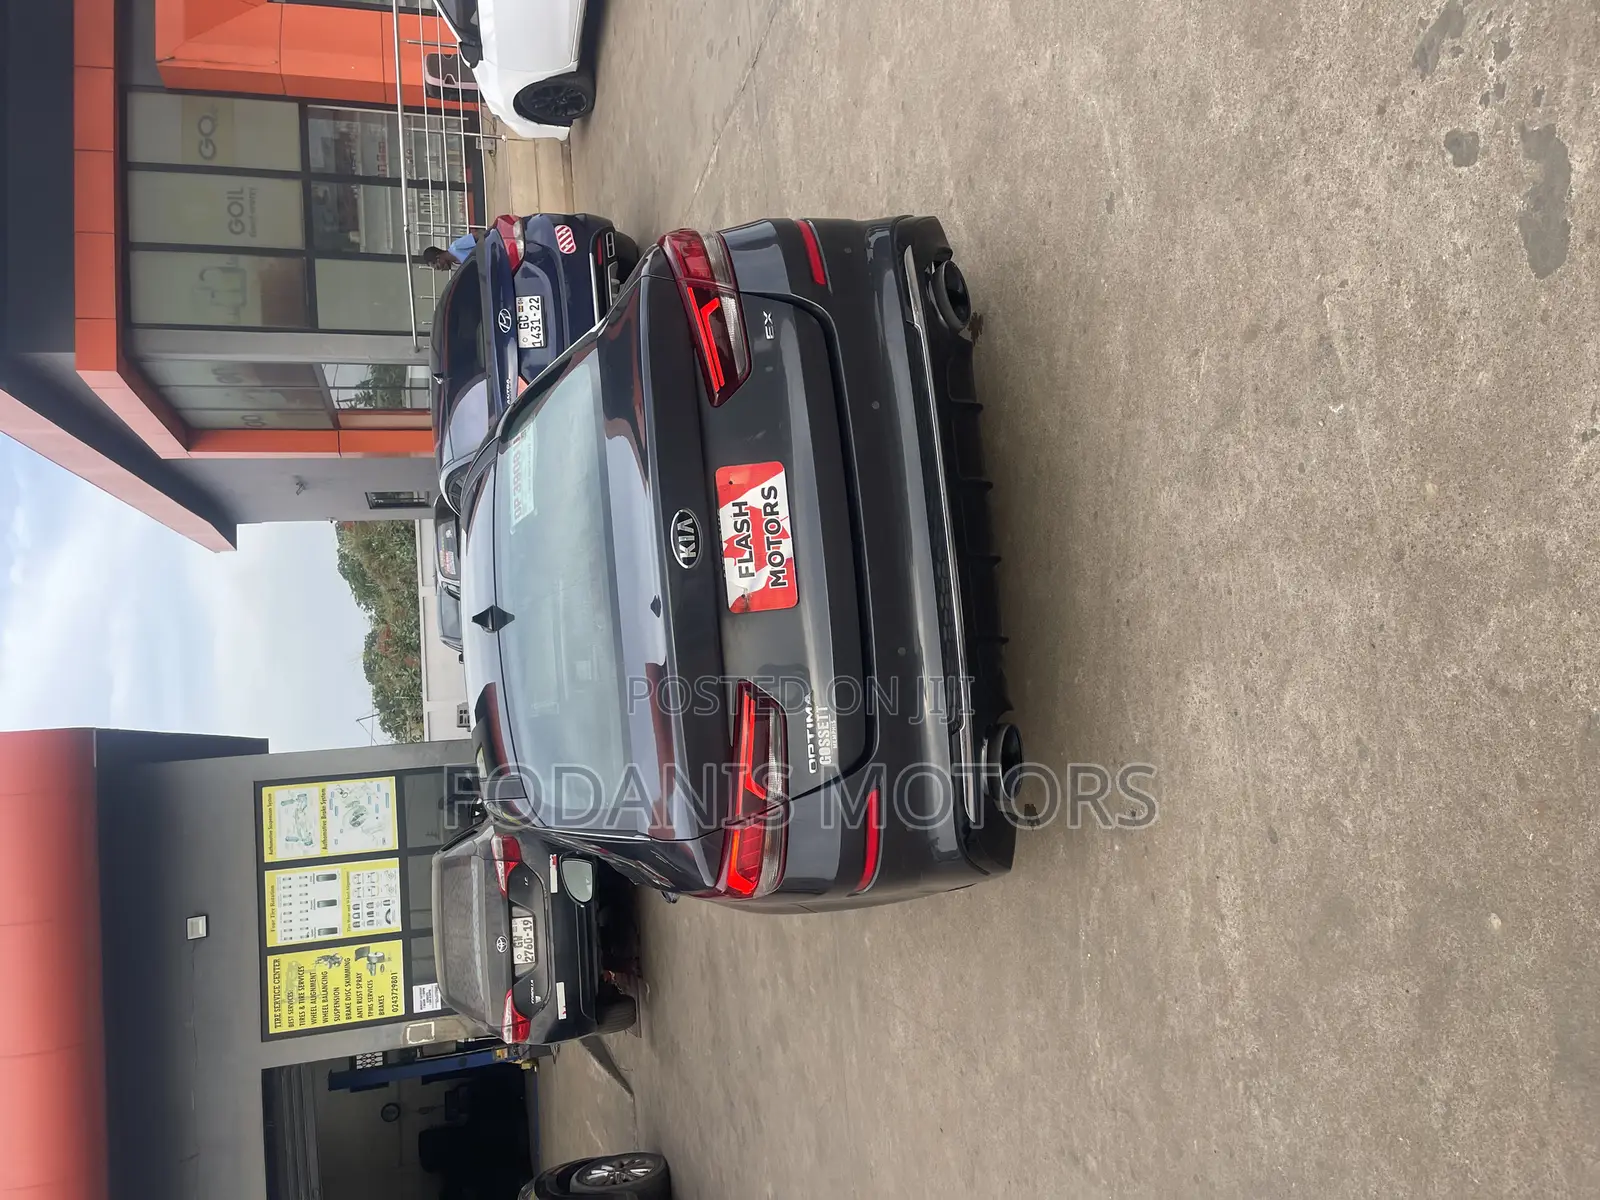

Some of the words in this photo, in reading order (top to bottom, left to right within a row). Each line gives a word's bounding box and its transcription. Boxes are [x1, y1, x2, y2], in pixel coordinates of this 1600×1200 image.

[227, 187, 245, 235] GOIL
[518, 315, 529, 330] GC
[529, 297, 542, 346] 1431-22
[763, 311, 774, 339] EX
[677, 518, 696, 558] KIA
[732, 501, 755, 578] FLASH
[760, 486, 787, 587] MOTORS
[804, 692, 817, 774] OPTIMA
[816, 705, 831, 765] GOSSETT
[513, 936, 523, 948] GW
